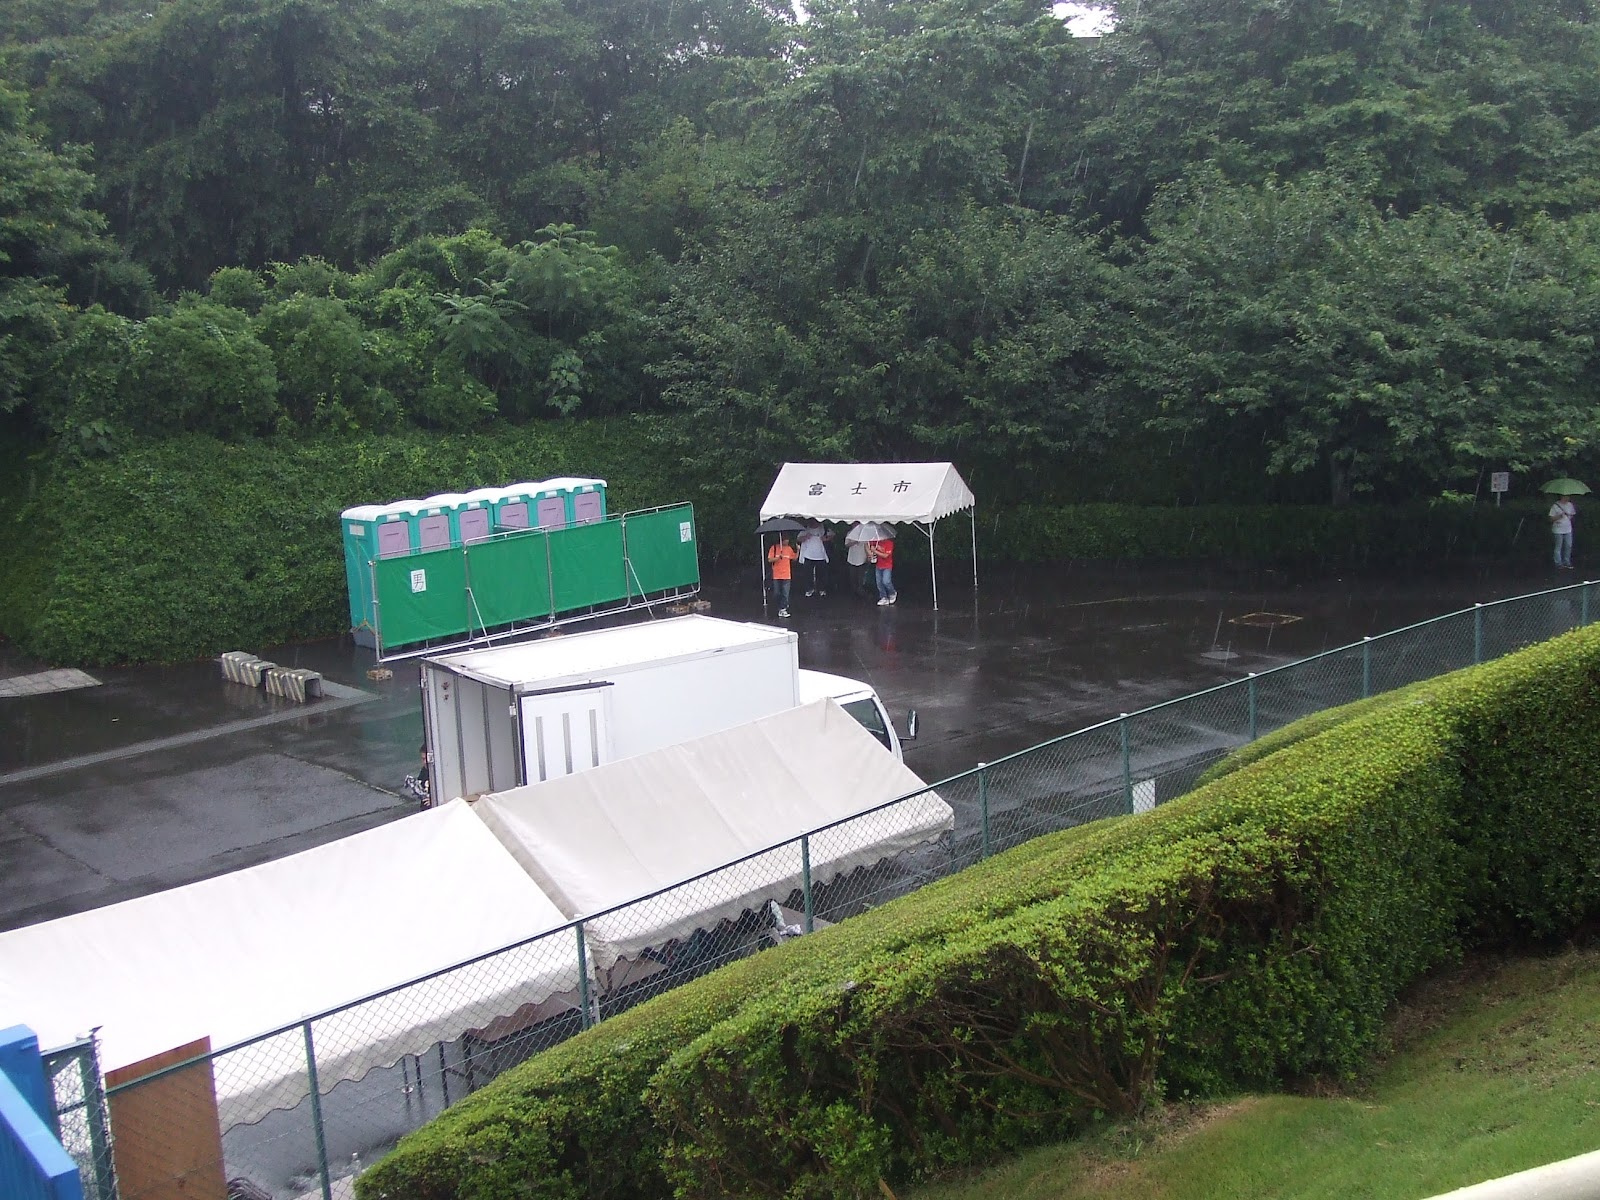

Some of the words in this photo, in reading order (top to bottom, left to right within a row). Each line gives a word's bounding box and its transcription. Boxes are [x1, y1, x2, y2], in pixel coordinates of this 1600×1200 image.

[808, 480, 912, 496] 富士市
[412, 573, 425, 591] 男
